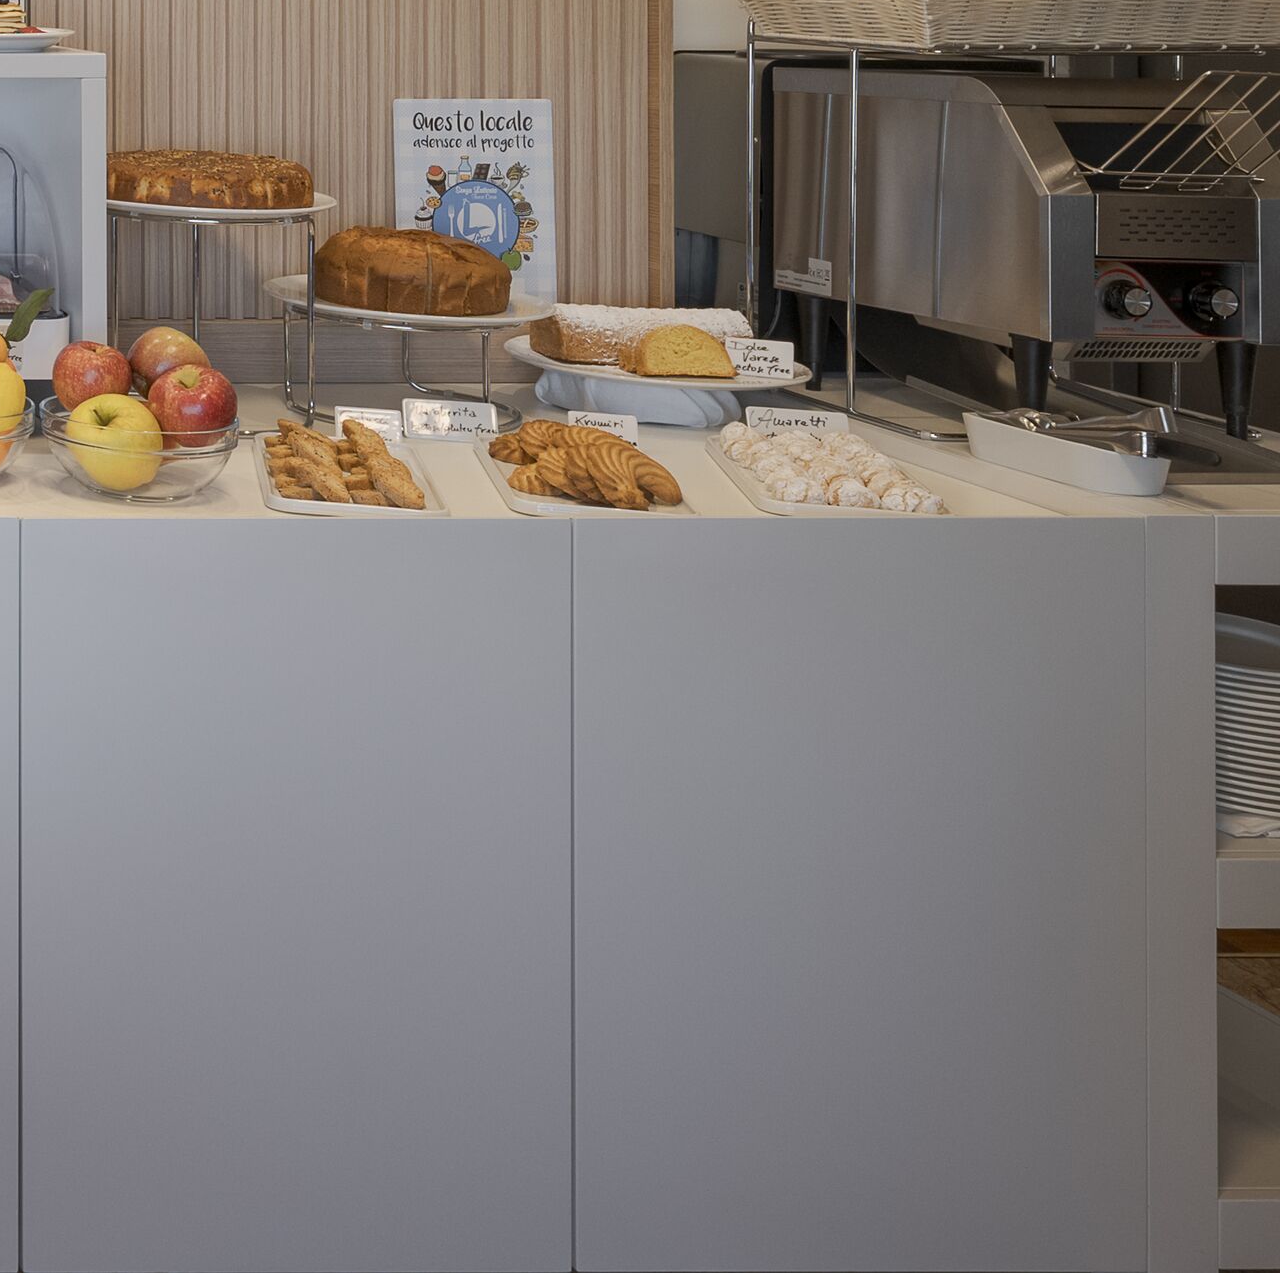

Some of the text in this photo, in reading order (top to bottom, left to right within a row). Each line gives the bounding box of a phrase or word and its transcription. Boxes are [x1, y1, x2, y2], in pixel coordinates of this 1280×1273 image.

[412, 110, 533, 132] Questo locale
[413, 134, 535, 152] aderisce al progetto
[735, 363, 764, 373] actose
